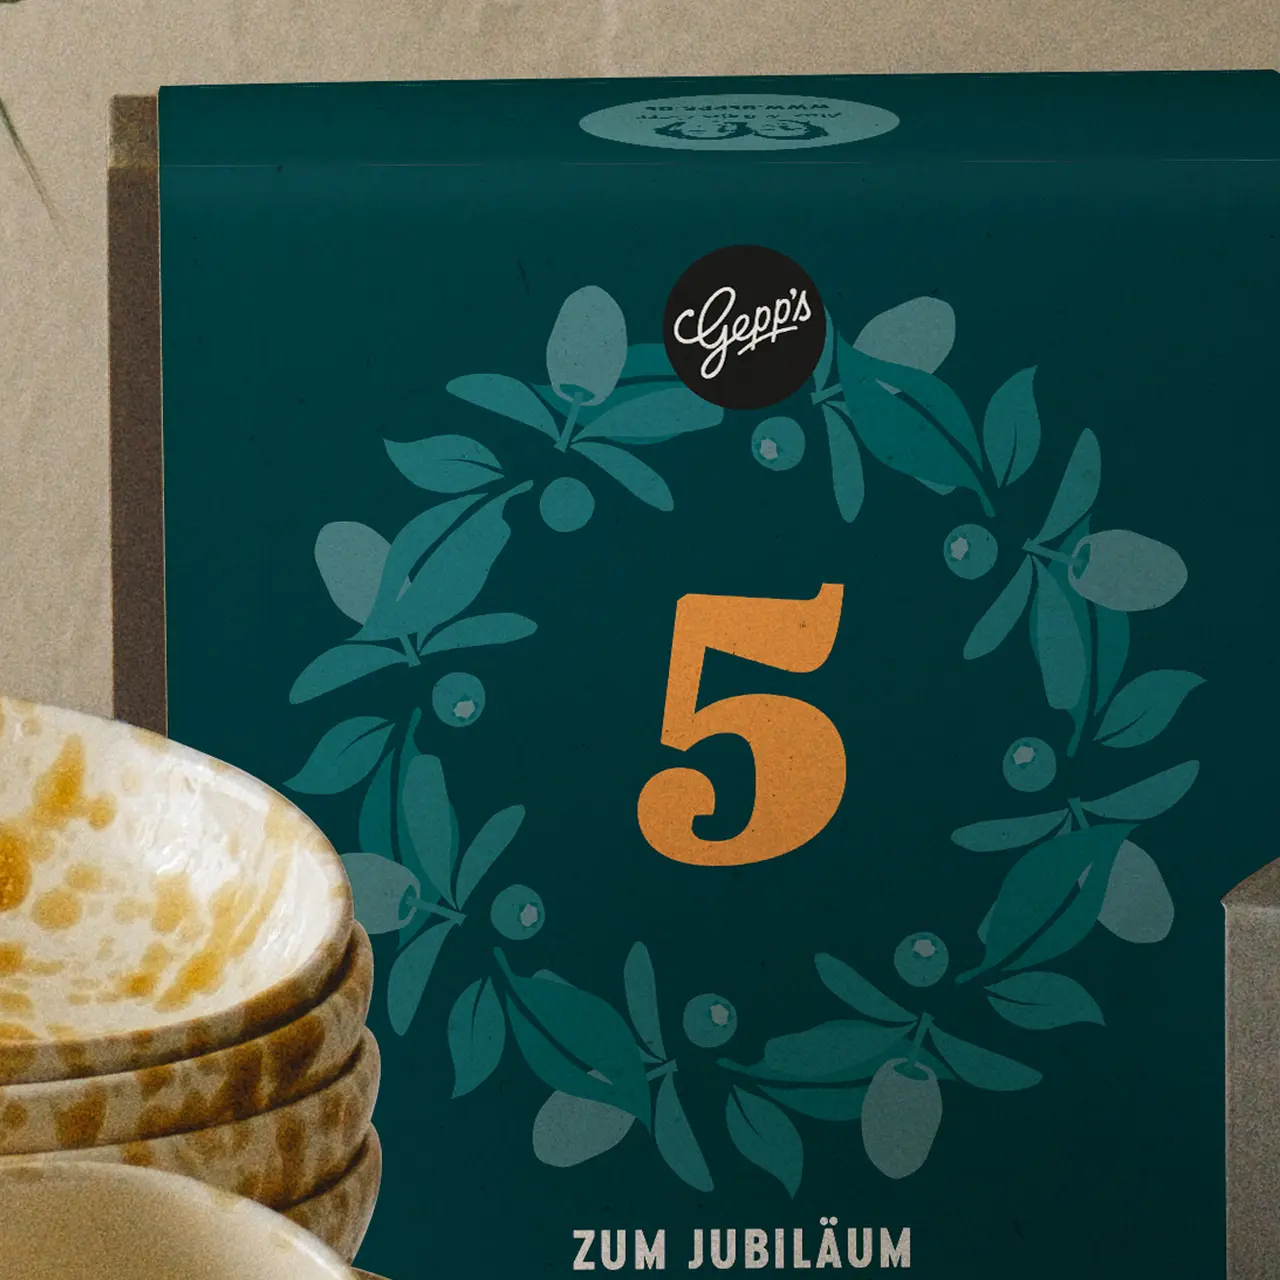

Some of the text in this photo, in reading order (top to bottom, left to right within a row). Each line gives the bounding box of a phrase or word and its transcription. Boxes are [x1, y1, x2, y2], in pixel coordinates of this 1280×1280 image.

[673, 286, 812, 380] Gepp's
[637, 583, 847, 867] 5
[572, 1216, 912, 1271] ZUM JUBILÄUM
